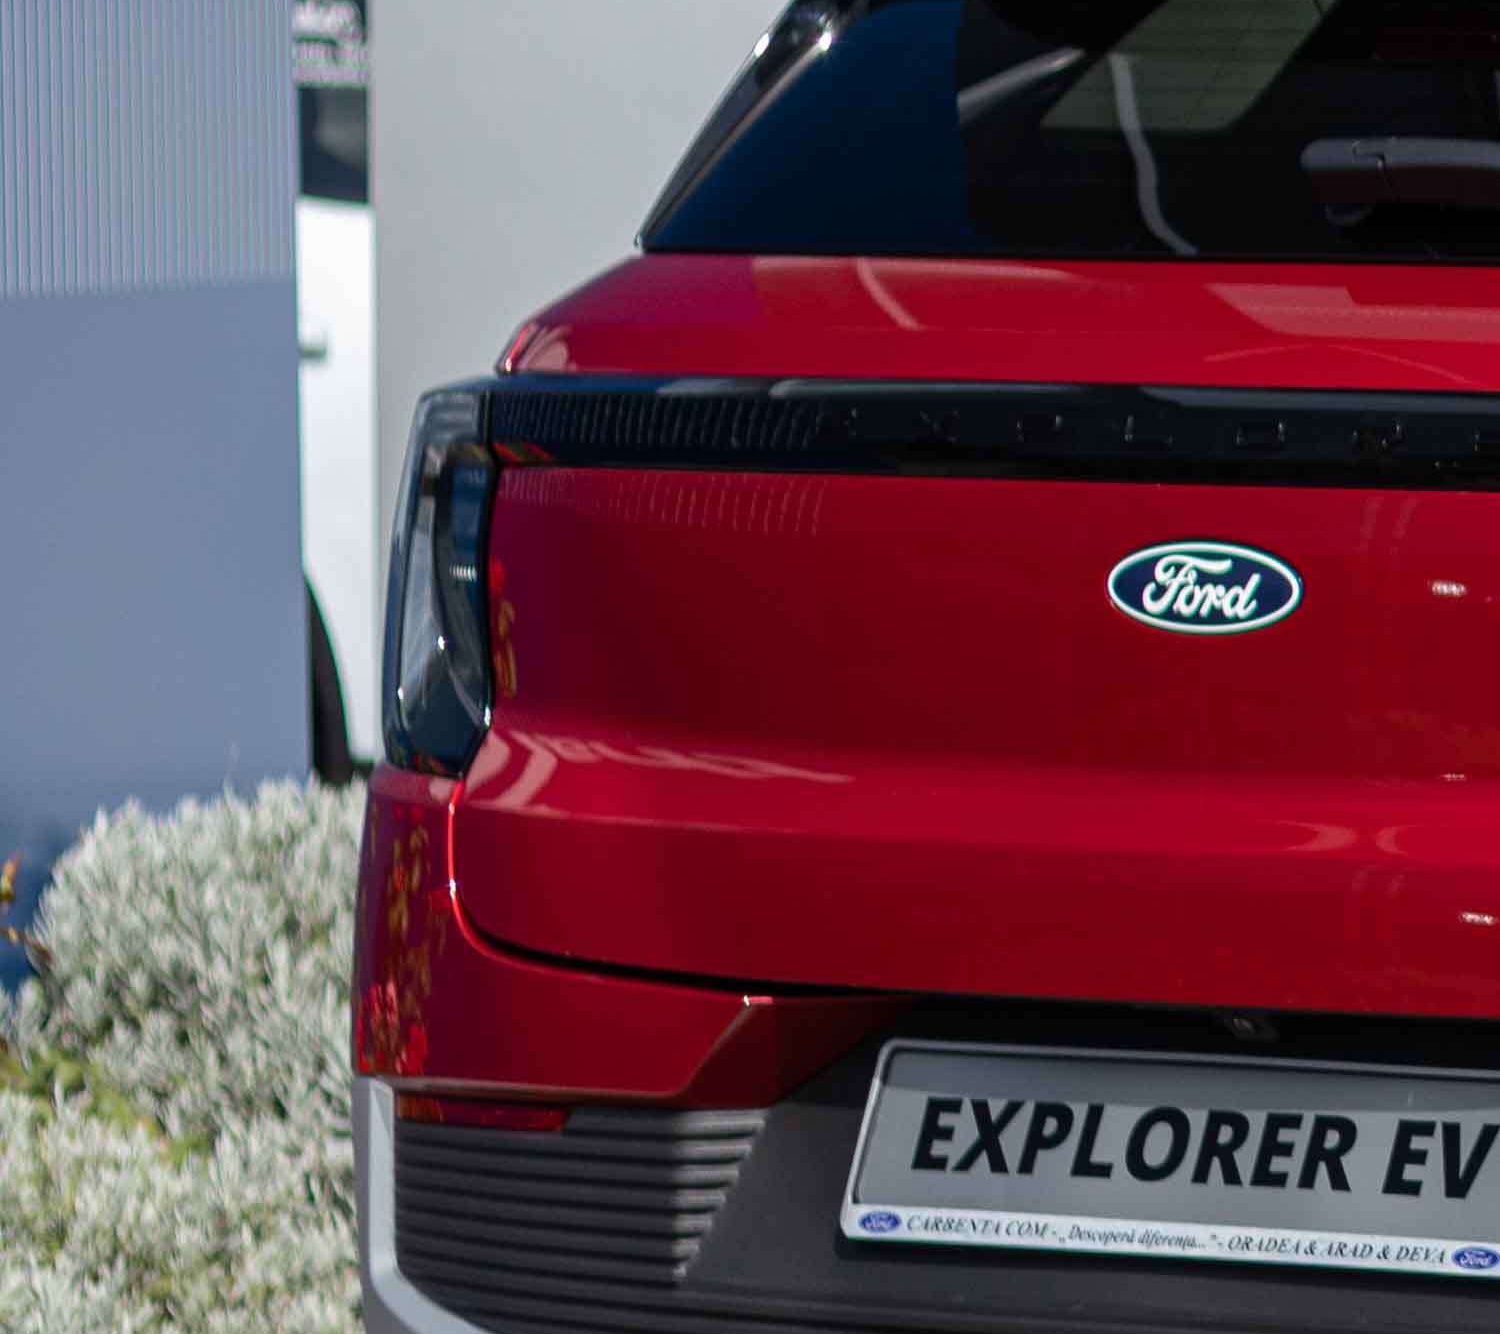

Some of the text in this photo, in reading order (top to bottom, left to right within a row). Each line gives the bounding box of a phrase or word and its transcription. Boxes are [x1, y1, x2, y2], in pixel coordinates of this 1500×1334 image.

[910, 1096, 1358, 1193] EXPLORER
[906, 1214, 1001, 1234] CARBENTA
[1005, 1219, 1049, 1238] COM
[1227, 1234, 1301, 1255] ORADEA
[1303, 1239, 1318, 1257] &
[1320, 1240, 1374, 1259] ARAD
[1376, 1244, 1390, 1261] &
[1395, 1244, 1446, 1264] DEVA
